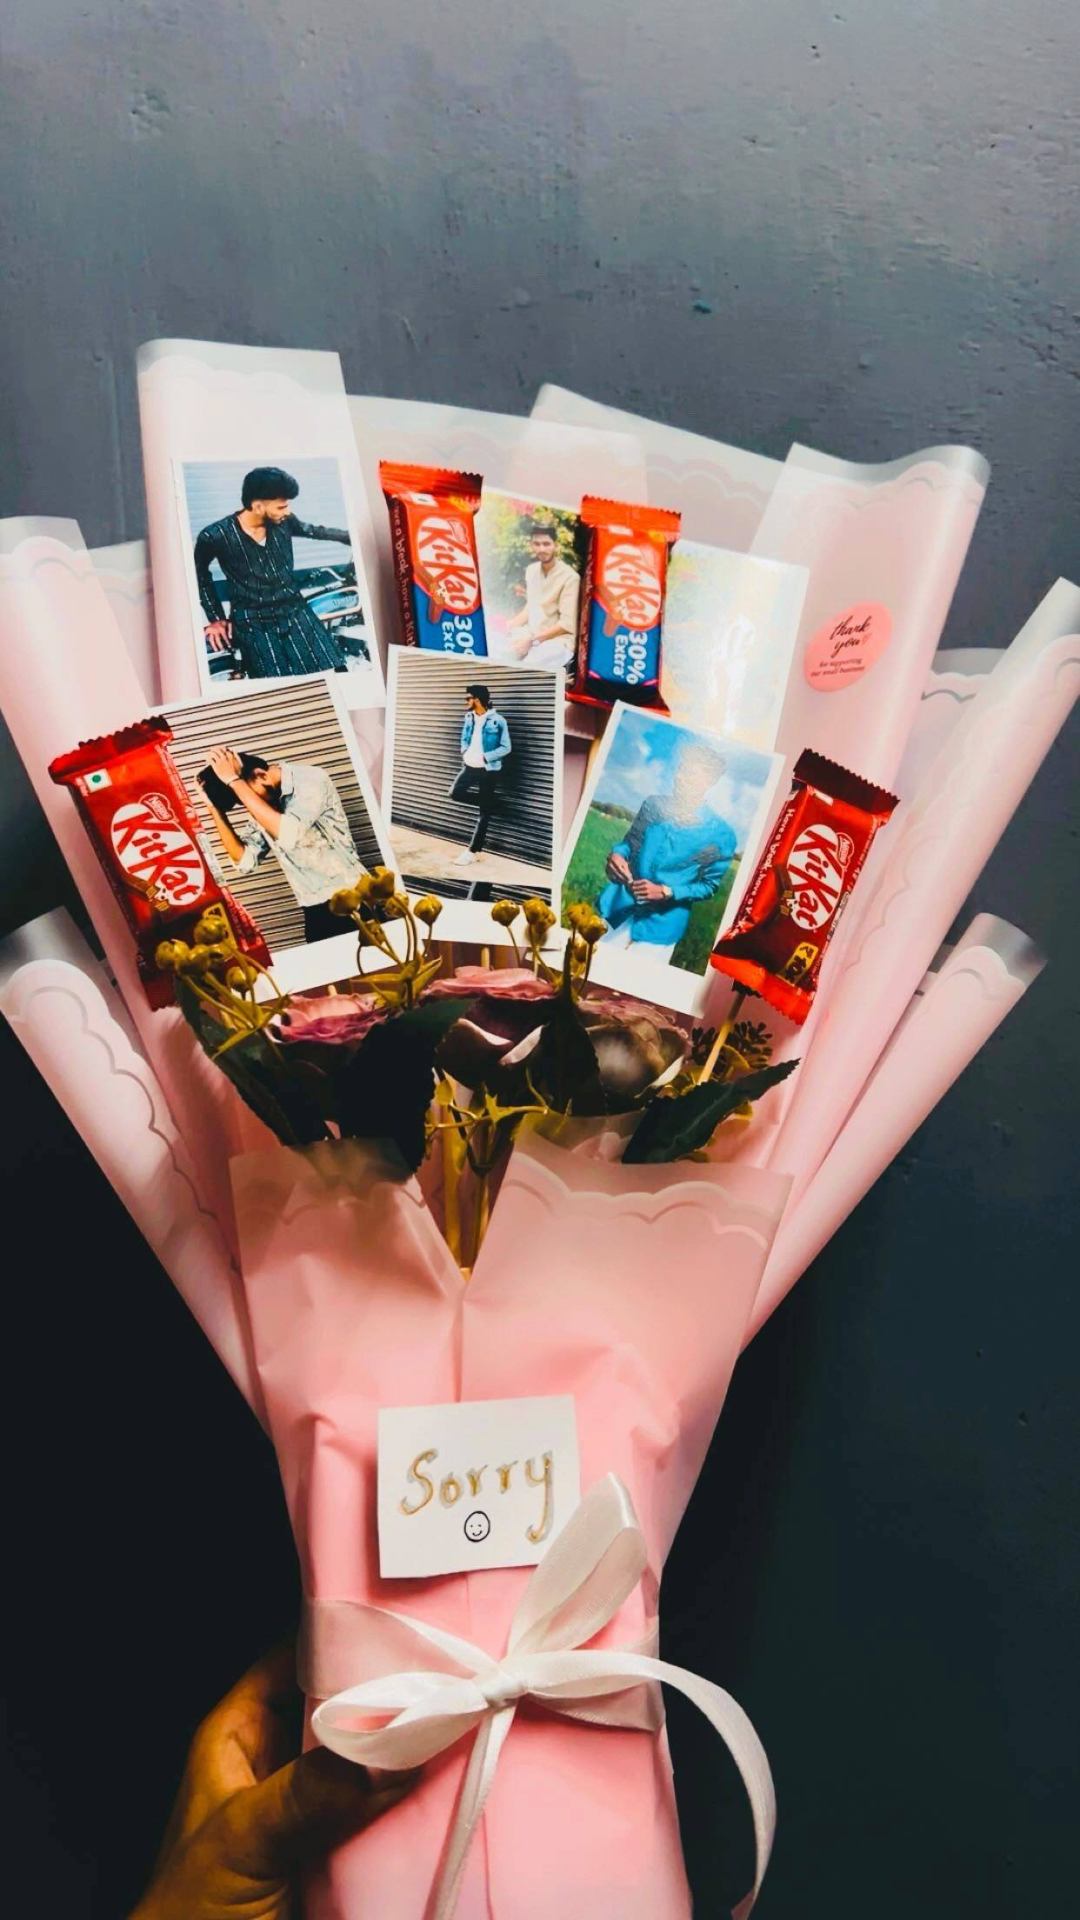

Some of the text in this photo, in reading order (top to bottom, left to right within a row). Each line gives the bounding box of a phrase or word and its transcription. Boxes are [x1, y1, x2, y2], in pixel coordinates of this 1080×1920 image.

[418, 525, 478, 607] KitKat
[605, 551, 660, 622] KitKat
[442, 621, 456, 652] Ext
[454, 615, 476, 656] 30
[627, 630, 648, 685] 30%
[829, 616, 872, 640] thank
[831, 637, 861, 659] you
[112, 811, 202, 902] KitKat
[787, 830, 843, 926] KitKat
[400, 1448, 553, 1544] Sorry
